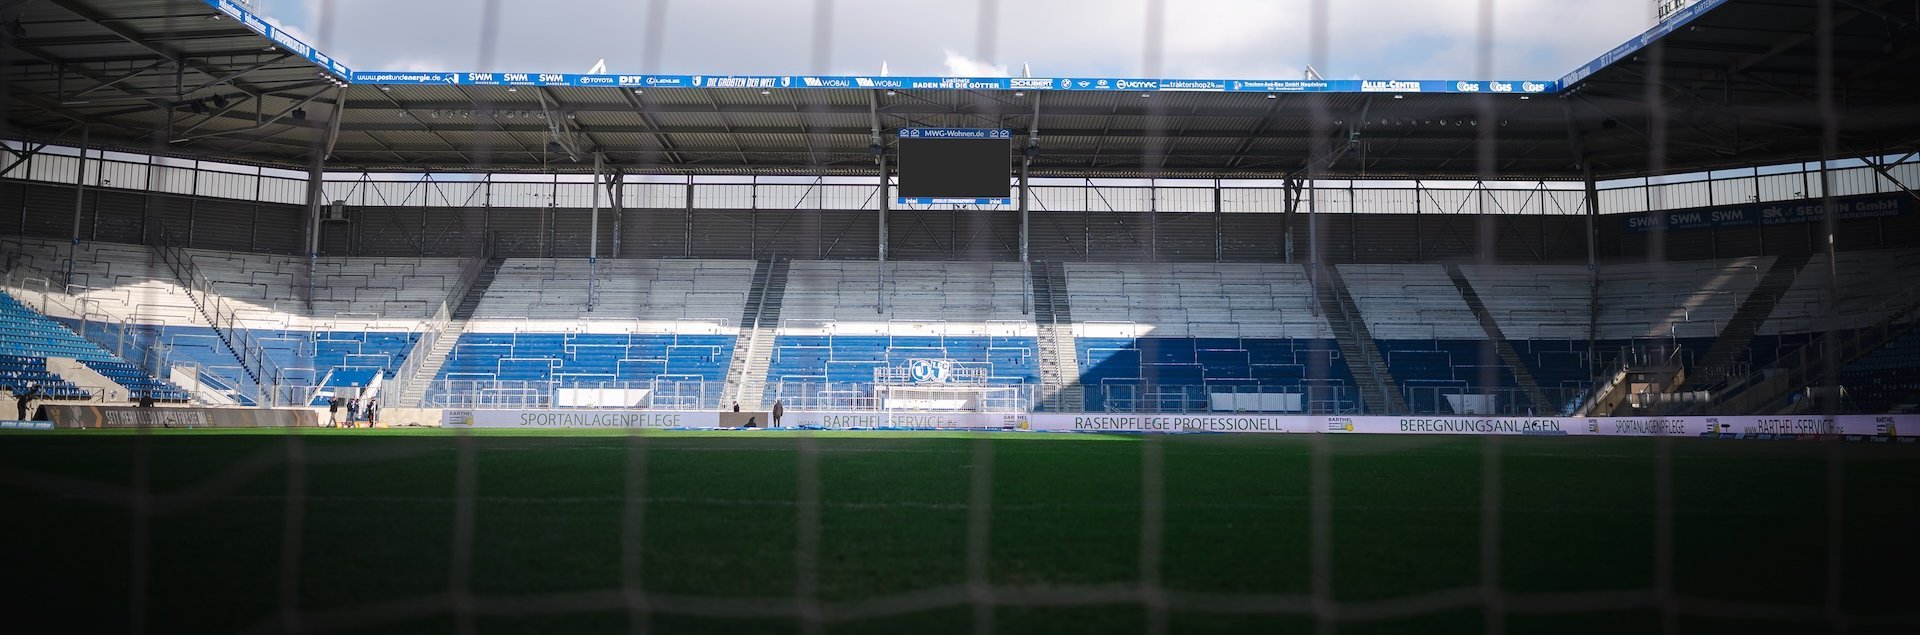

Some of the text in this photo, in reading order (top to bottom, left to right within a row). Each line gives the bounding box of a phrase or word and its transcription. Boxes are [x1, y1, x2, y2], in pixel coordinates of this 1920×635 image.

[357, 74, 441, 82] www.postundenergie.de
[468, 73, 493, 81] SWM
[503, 73, 528, 82] SWM
[539, 74, 564, 82] SWM
[707, 77, 718, 87] DIE
[746, 77, 759, 87] DER
[760, 77, 777, 87] WELT
[1361, 80, 1420, 88] ALLEE-CENTER
[1856, 199, 1898, 212] GmbH
[1671, 213, 1701, 224] SWM
[1712, 210, 1743, 221] SWM
[1630, 217, 1659, 227] SWM
[520, 413, 681, 426] SPORTANLAGENPFLEGE
[1075, 417, 1283, 431] RASENPFLEGE PROFESSIONELL
[1400, 419, 1561, 433] BEREGNUNGSANLAGEN
[1615, 420, 1685, 434] SPORTANLAGENPFLEGE
